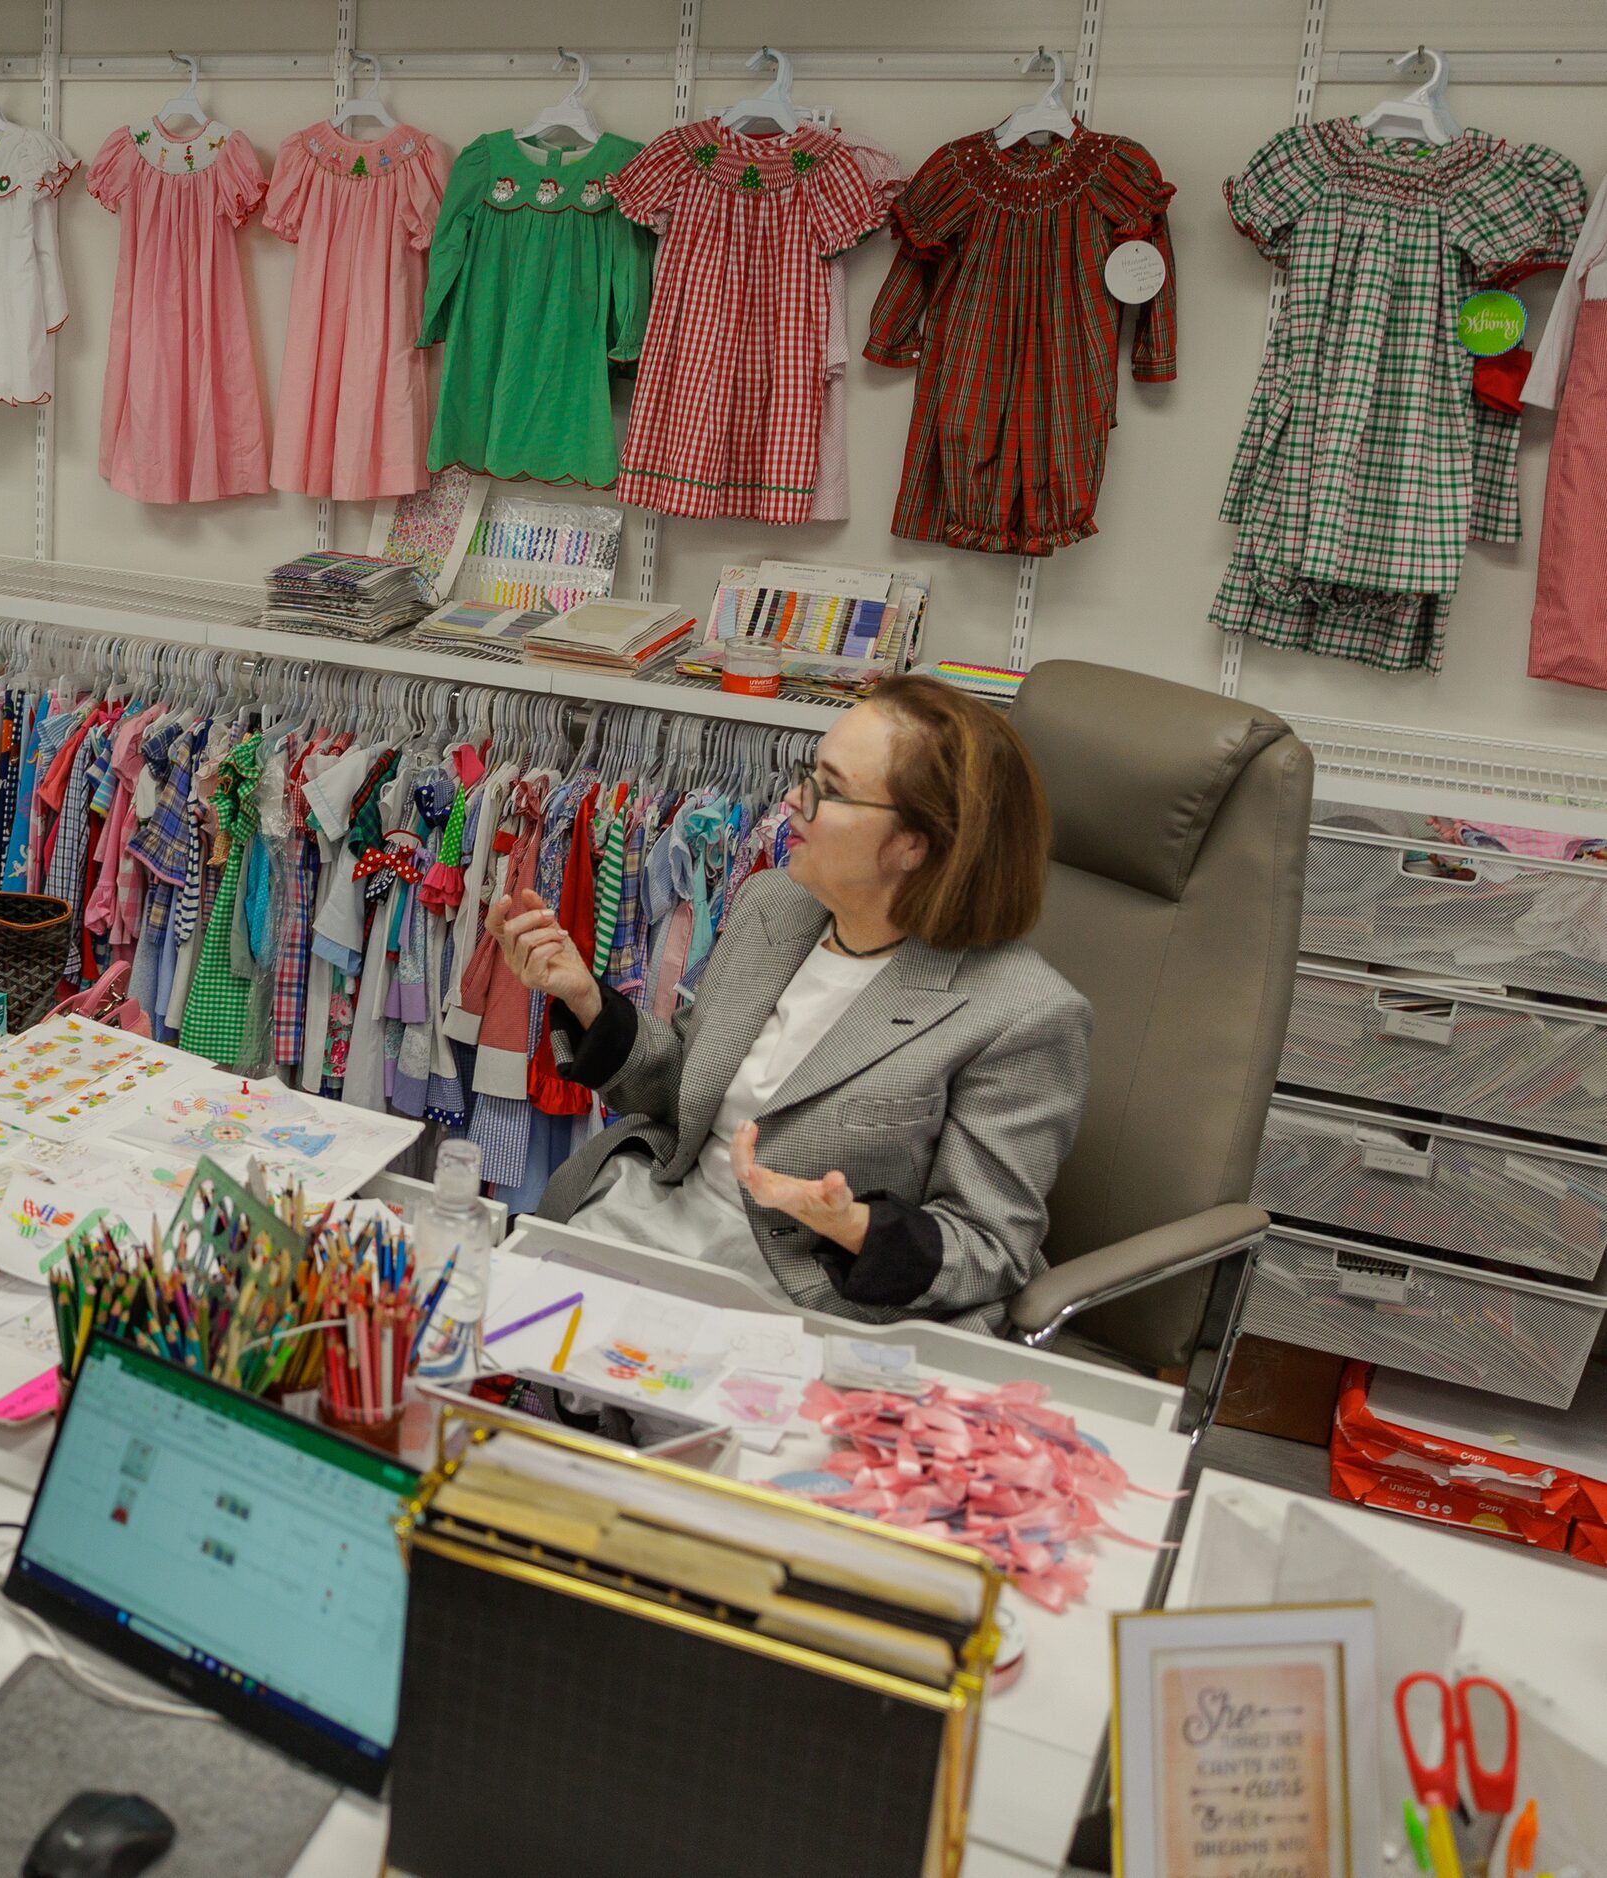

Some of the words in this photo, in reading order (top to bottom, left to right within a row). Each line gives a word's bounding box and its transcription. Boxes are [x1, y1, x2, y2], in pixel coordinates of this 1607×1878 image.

[1460, 1451, 1487, 1464] Copy
[1389, 1482, 1431, 1498] universal
[1478, 1502, 1504, 1514] Copy
[1182, 1686, 1254, 1747] She
